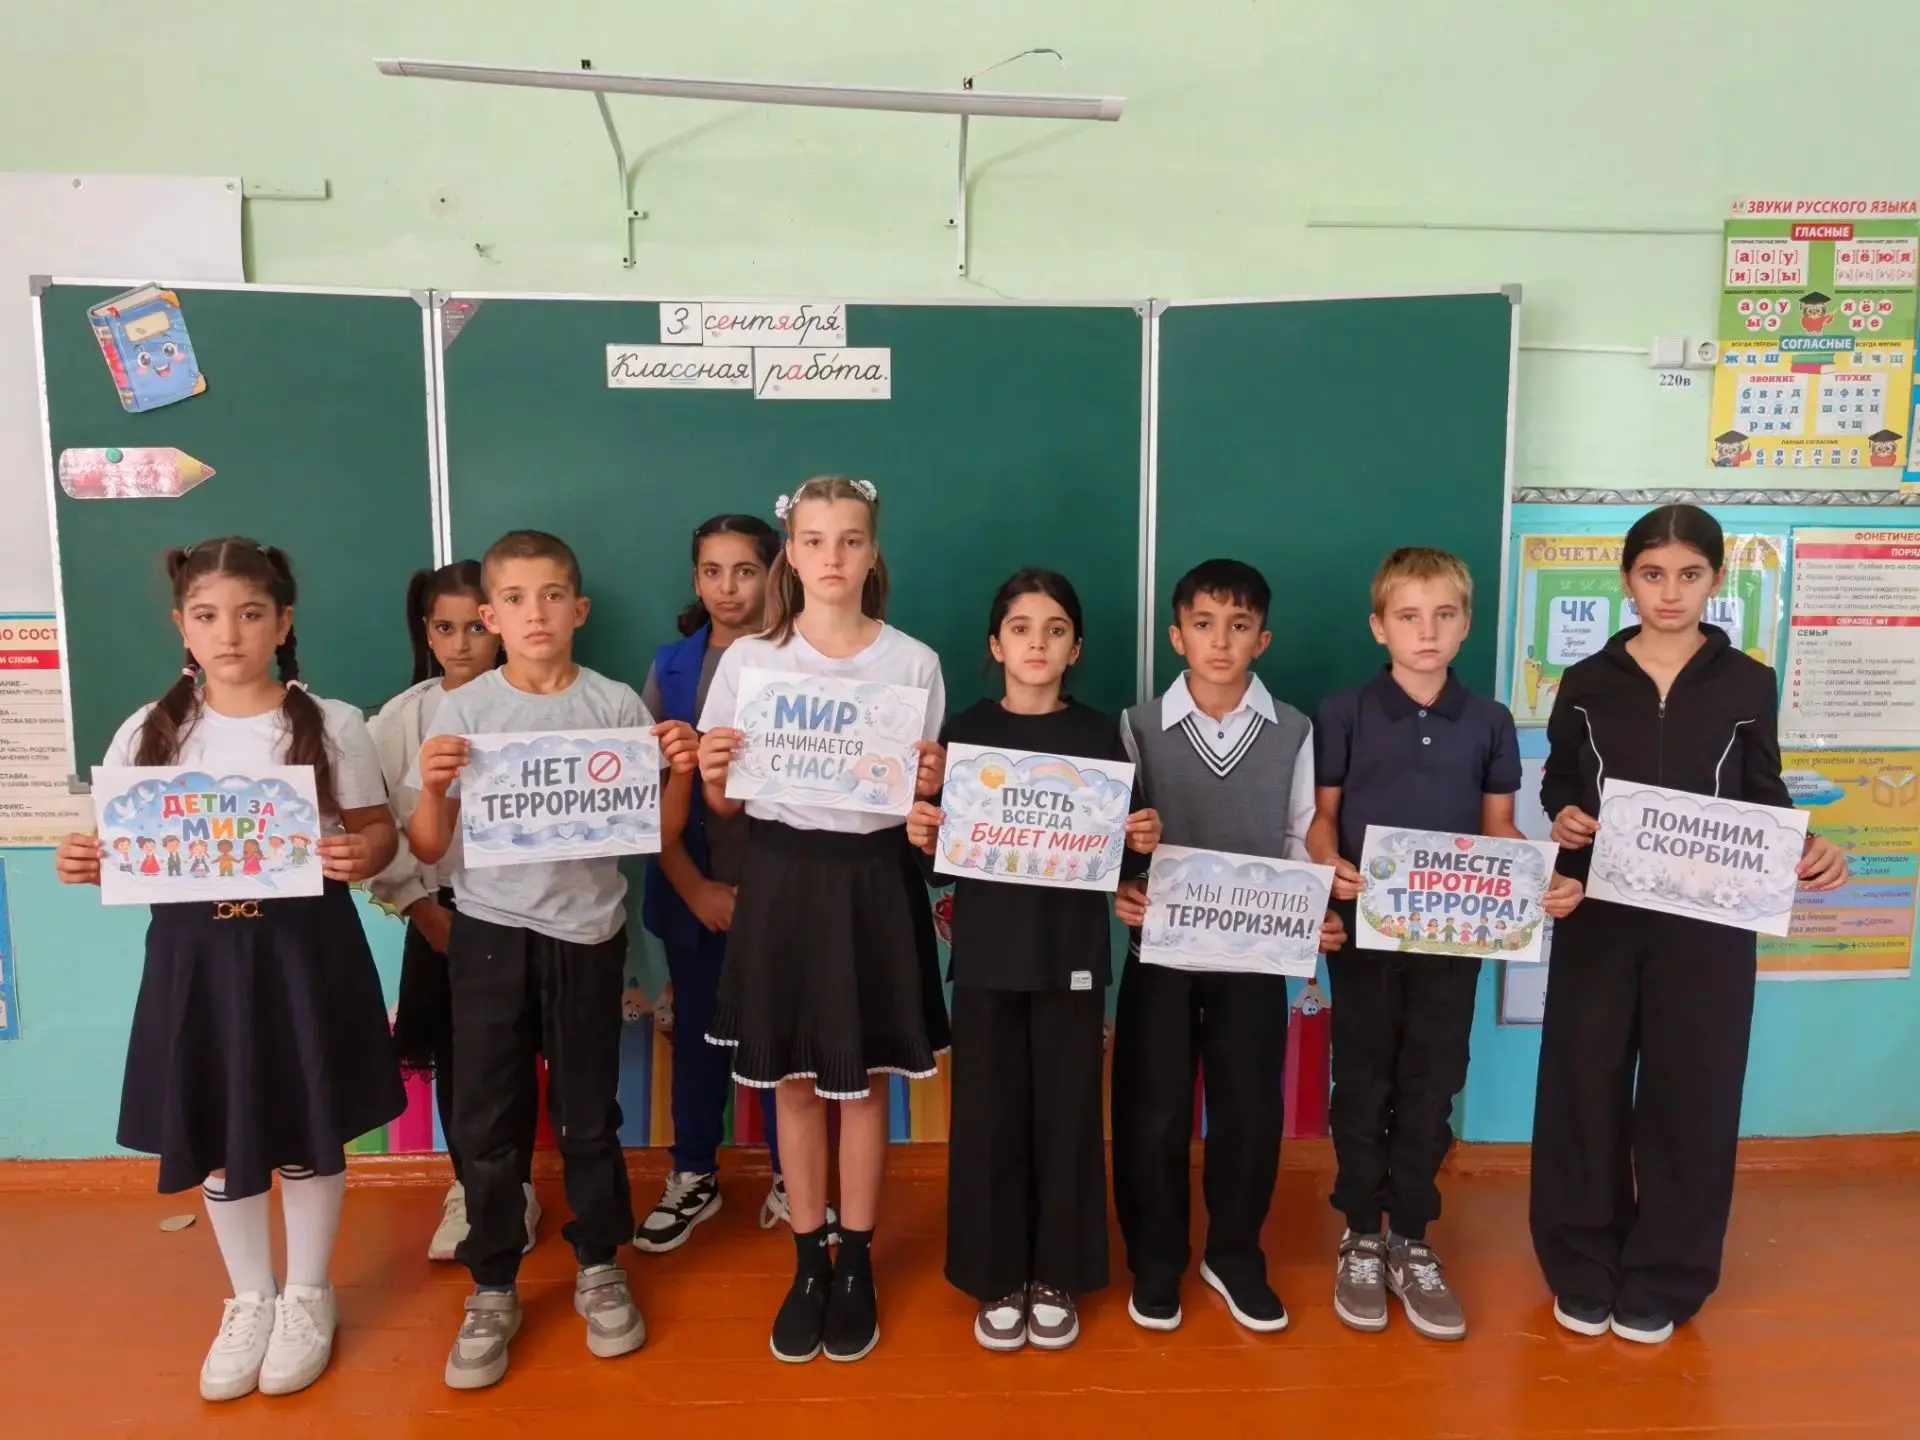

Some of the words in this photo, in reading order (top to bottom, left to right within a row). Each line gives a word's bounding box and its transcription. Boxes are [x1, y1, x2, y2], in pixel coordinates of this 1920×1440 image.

[1748, 201, 1792, 213] ЗВУКИ
[1796, 201, 1867, 213] РУССКОГО
[1871, 201, 1917, 213] ЯЗЫКА
[1795, 226, 1850, 237] ГЛАСНЫЕ
[667, 307, 689, 335] 3
[1781, 338, 1852, 349] СОГЛАСНЫЕ
[611, 353, 749, 379] Классная
[1750, 375, 1794, 383] ЗВОНКИЕ
[1835, 374, 1872, 382] ГЛУХИЕ
[1659, 374, 1691, 386] 220в
[1561, 600, 1596, 622] ЧК
[1797, 629, 1828, 637] СЕМЬЯ
[7, 656, 40, 665] СЛОВА
[774, 694, 858, 734] МИР
[765, 732, 863, 756] НАЧИНАЕТСЯ
[521, 757, 581, 787] НЕТ
[771, 754, 782, 771] С
[786, 754, 845, 781] НАС!
[161, 793, 237, 819] ДЕТИ
[248, 799, 275, 817] ЗА
[481, 784, 658, 822] ТЕРРОРИЗМУ!
[1002, 787, 1075, 813] ПУСТЬ
[182, 817, 267, 842] МИР!
[1002, 809, 1073, 830] ВСЕГДА
[1641, 807, 1770, 850] ПОМНИМ.
[971, 822, 1046, 848] БУДЕТ
[1048, 831, 1110, 854] МИР!
[1413, 849, 1513, 877] ВМЕСТЕ
[1636, 832, 1770, 874] СКОРБИМ.
[1408, 871, 1512, 897] ПРОТИВ
[1184, 882, 1222, 904] МЫ
[1231, 887, 1309, 913] ПРОТИВ
[1387, 887, 1529, 922] ТЕРРОРА!
[1166, 903, 1315, 940] ТЕРРОРИЗМА!
[1359, 1240, 1379, 1250] NIKE
[1410, 1248, 1428, 1257] NIKE
